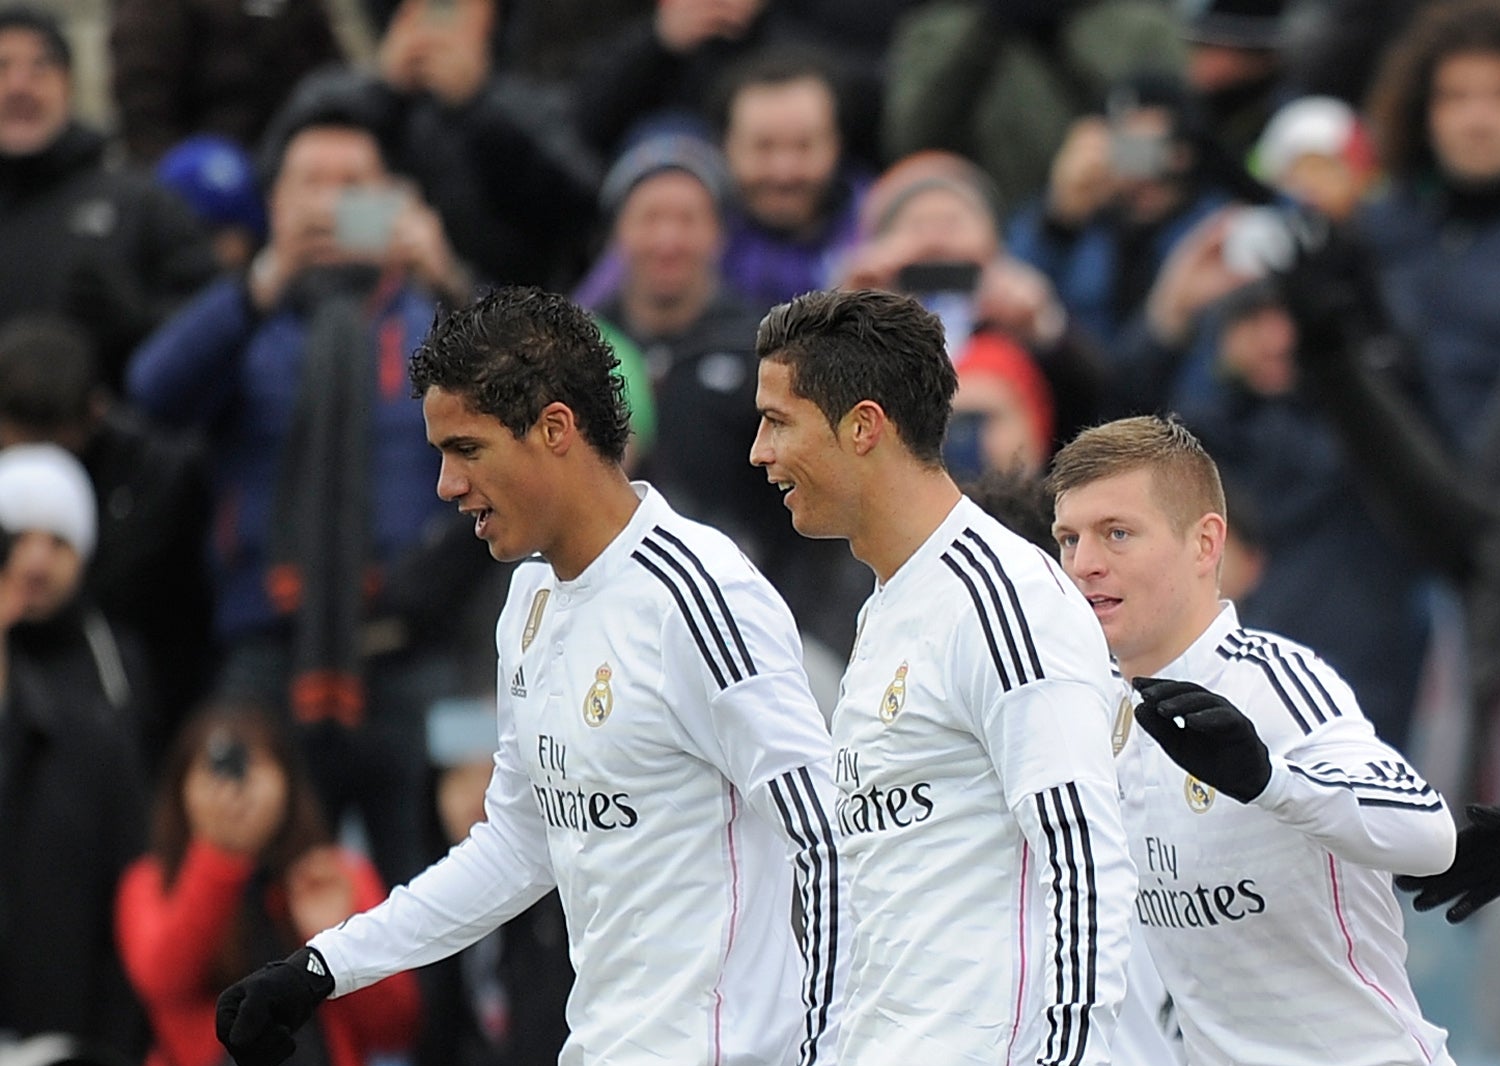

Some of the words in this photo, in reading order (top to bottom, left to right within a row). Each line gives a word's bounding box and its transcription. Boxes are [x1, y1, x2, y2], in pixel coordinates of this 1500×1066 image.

[538, 734, 566, 779] Fly
[836, 747, 860, 788] Fly
[1145, 836, 1178, 880] Fly
